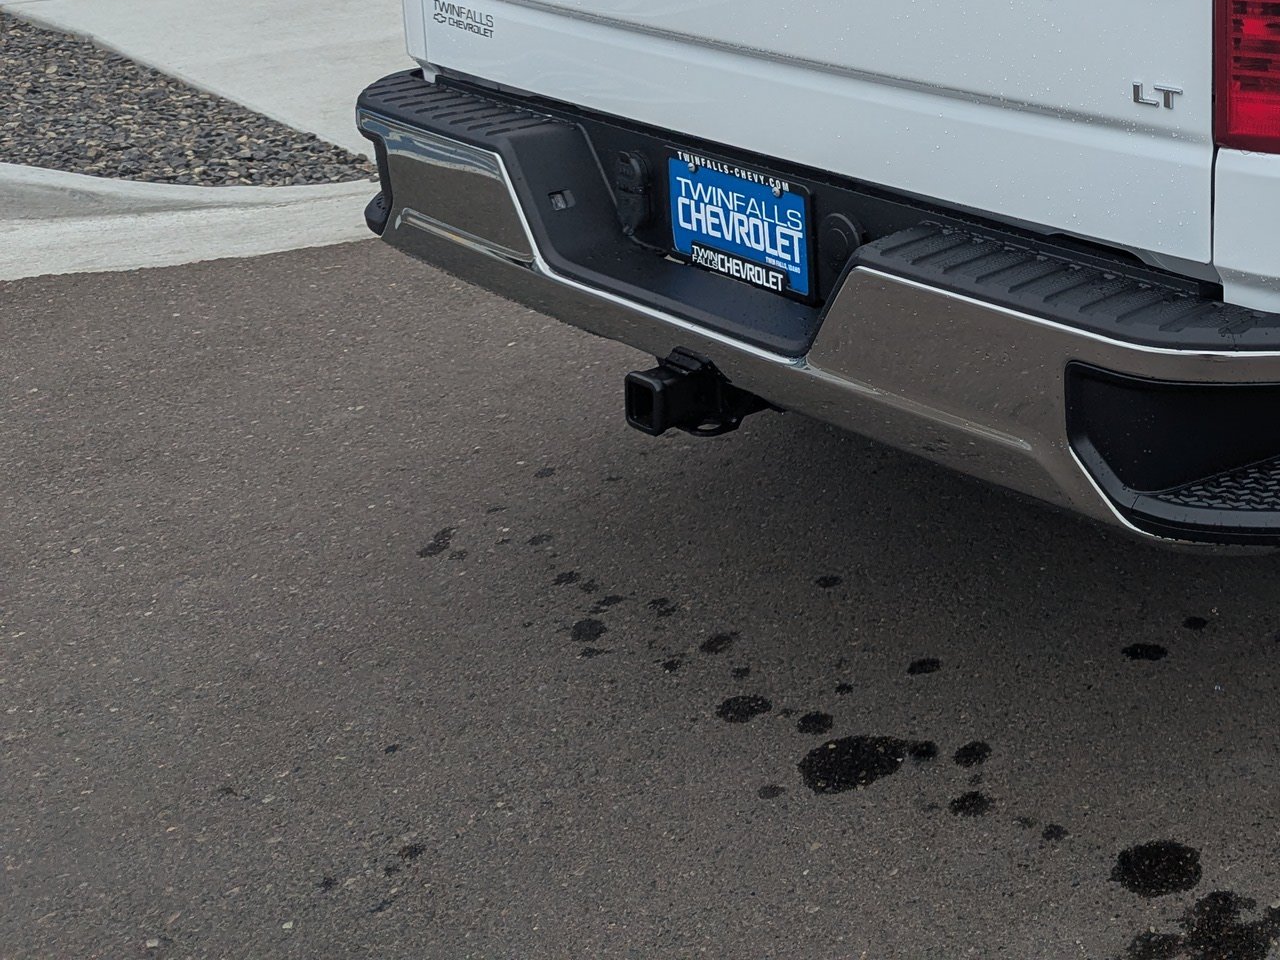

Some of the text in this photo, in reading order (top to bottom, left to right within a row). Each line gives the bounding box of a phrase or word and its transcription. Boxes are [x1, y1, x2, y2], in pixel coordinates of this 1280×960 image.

[448, 16, 494, 39] CHEVROLET
[1132, 82, 1183, 109] LT
[676, 176, 803, 230] TWINFALLS
[677, 196, 803, 264] CHEVROLET
[691, 245, 718, 261] TWIN
[692, 254, 719, 270] FALLS
[718, 253, 783, 291] CHEVROLET
